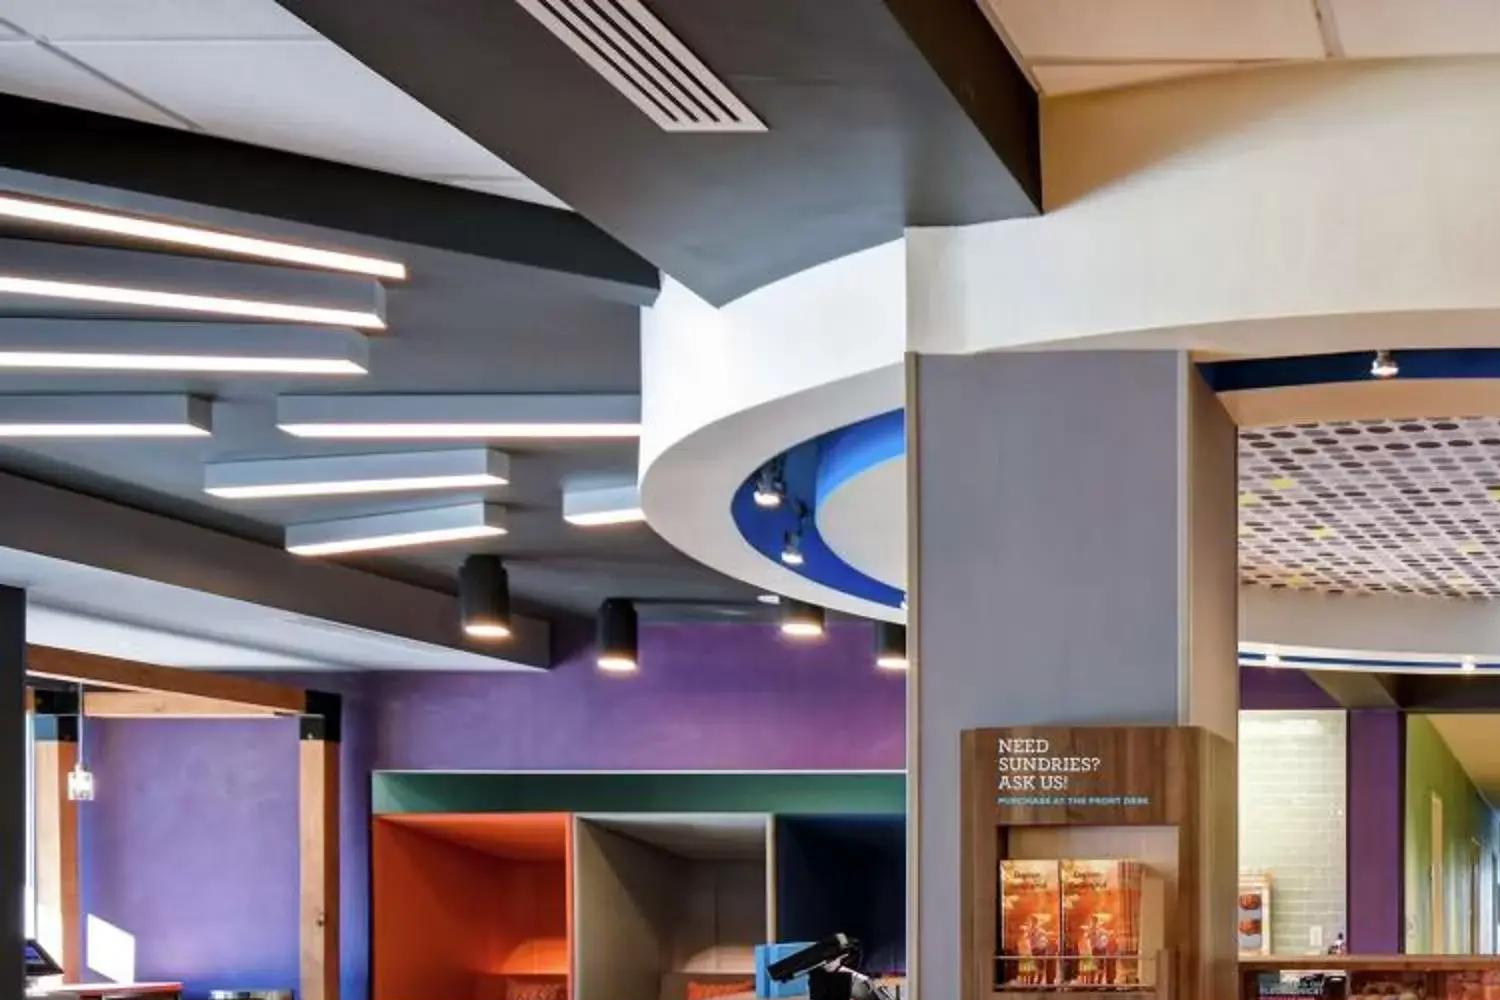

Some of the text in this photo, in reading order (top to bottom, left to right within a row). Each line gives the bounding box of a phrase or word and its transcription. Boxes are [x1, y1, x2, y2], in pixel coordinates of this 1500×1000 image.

[998, 738, 1049, 753] NEED
[998, 757, 1100, 772] SUNDRIES?
[998, 775, 1068, 790] ASK US!
[1067, 796, 1086, 805] THE
